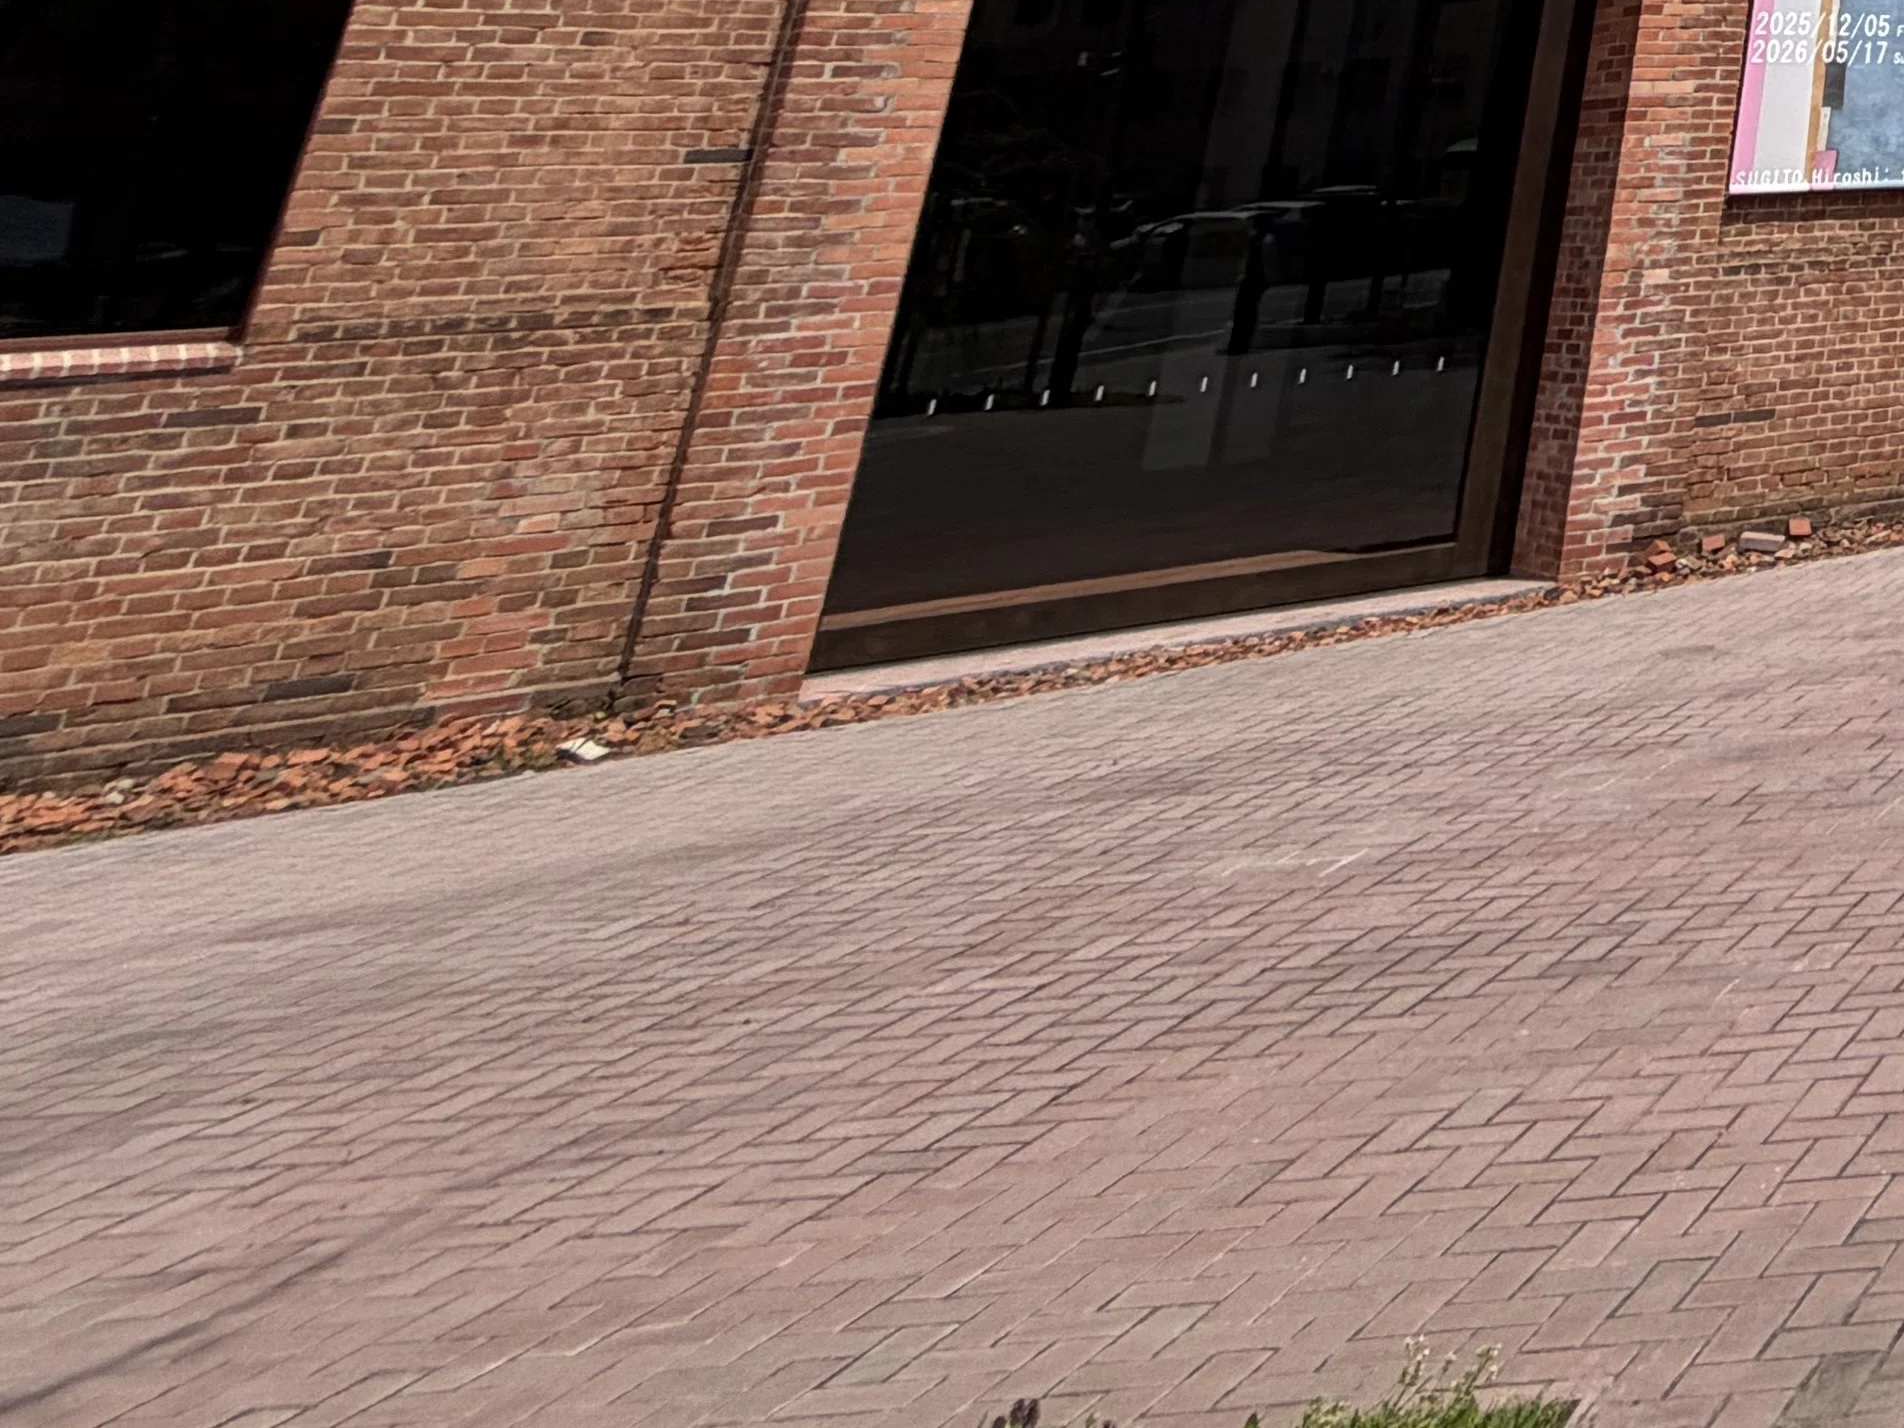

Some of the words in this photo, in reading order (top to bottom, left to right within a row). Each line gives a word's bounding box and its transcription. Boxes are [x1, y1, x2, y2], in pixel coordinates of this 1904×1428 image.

[1754, 10, 1892, 39] 2025/12/05
[1750, 38, 1889, 65] 2026/05/17
[1733, 166, 1804, 184] SUGITO
